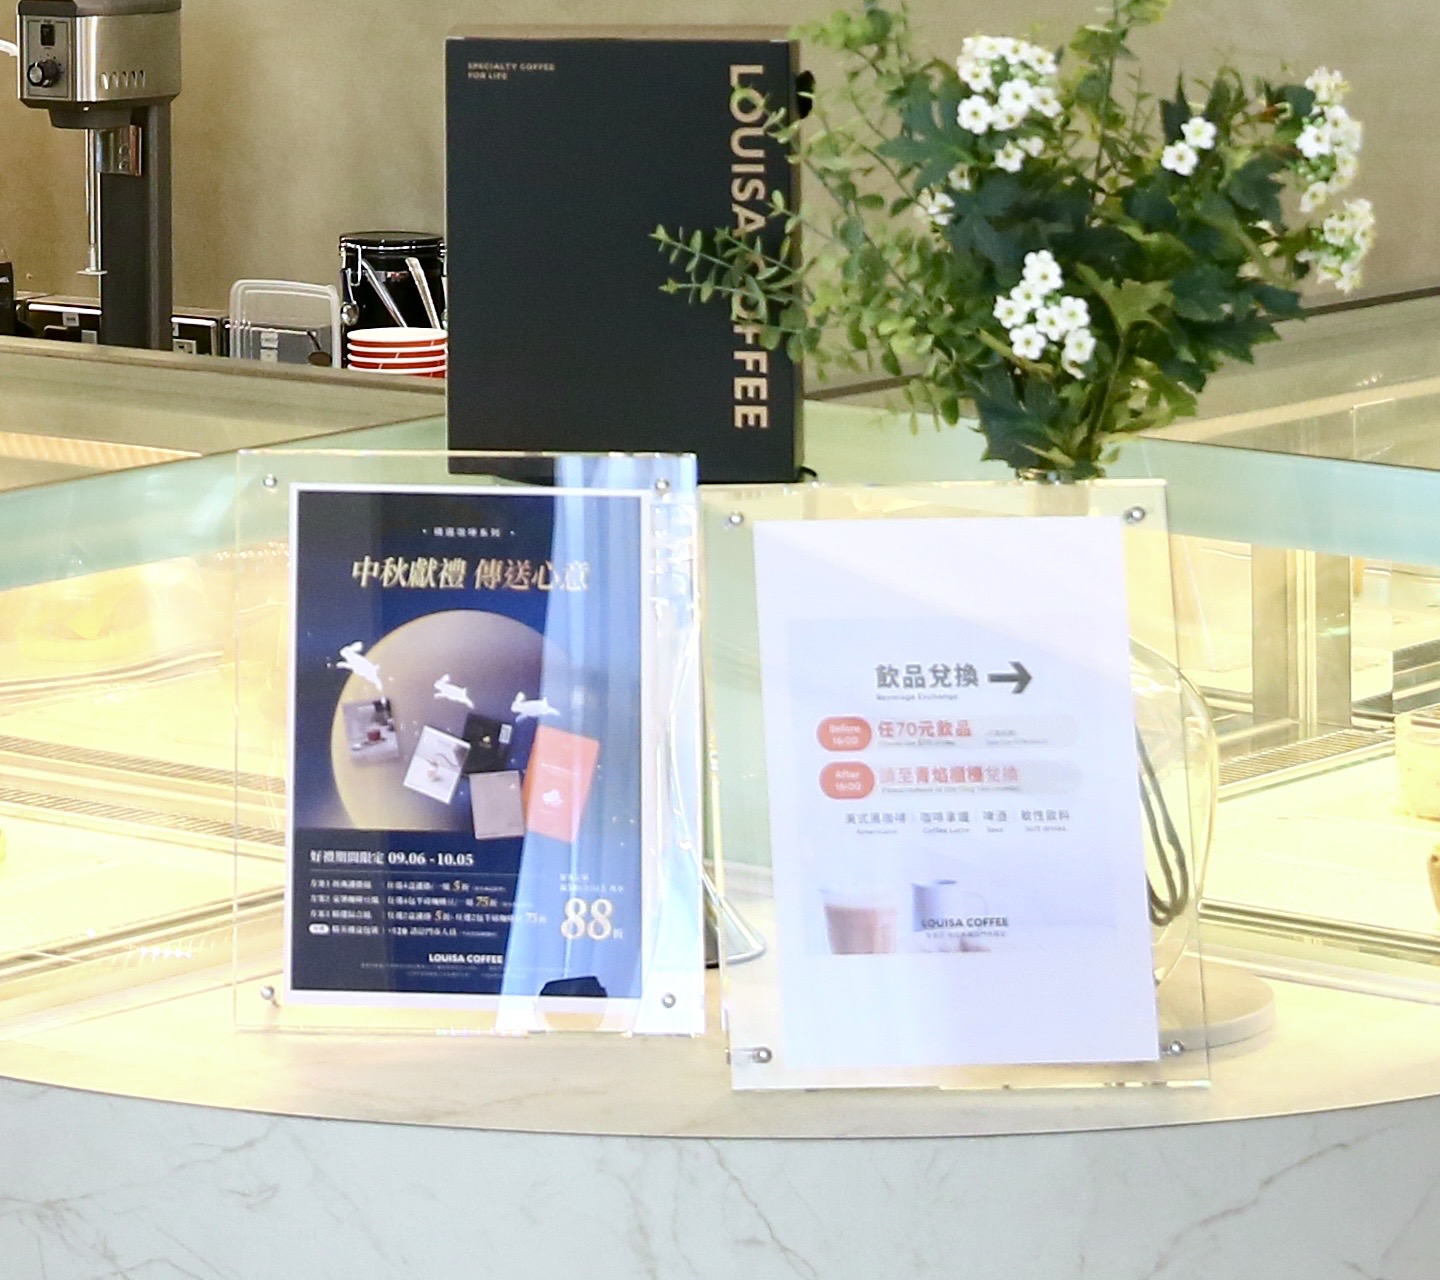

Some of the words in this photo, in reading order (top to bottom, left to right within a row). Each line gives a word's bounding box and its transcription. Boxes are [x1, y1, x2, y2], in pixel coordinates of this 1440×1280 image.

[729, 64, 767, 238] LOUISA
[351, 555, 466, 589] 中秋獻禮
[474, 558, 590, 591] 傳送心意
[875, 663, 979, 689] 飲品兌換
[387, 851, 426, 865] 09.06
[921, 918, 963, 928] LOUISA
[966, 917, 1009, 927] COFFEE
[428, 953, 465, 963] LOUISA
[466, 954, 503, 964] COFFEE
